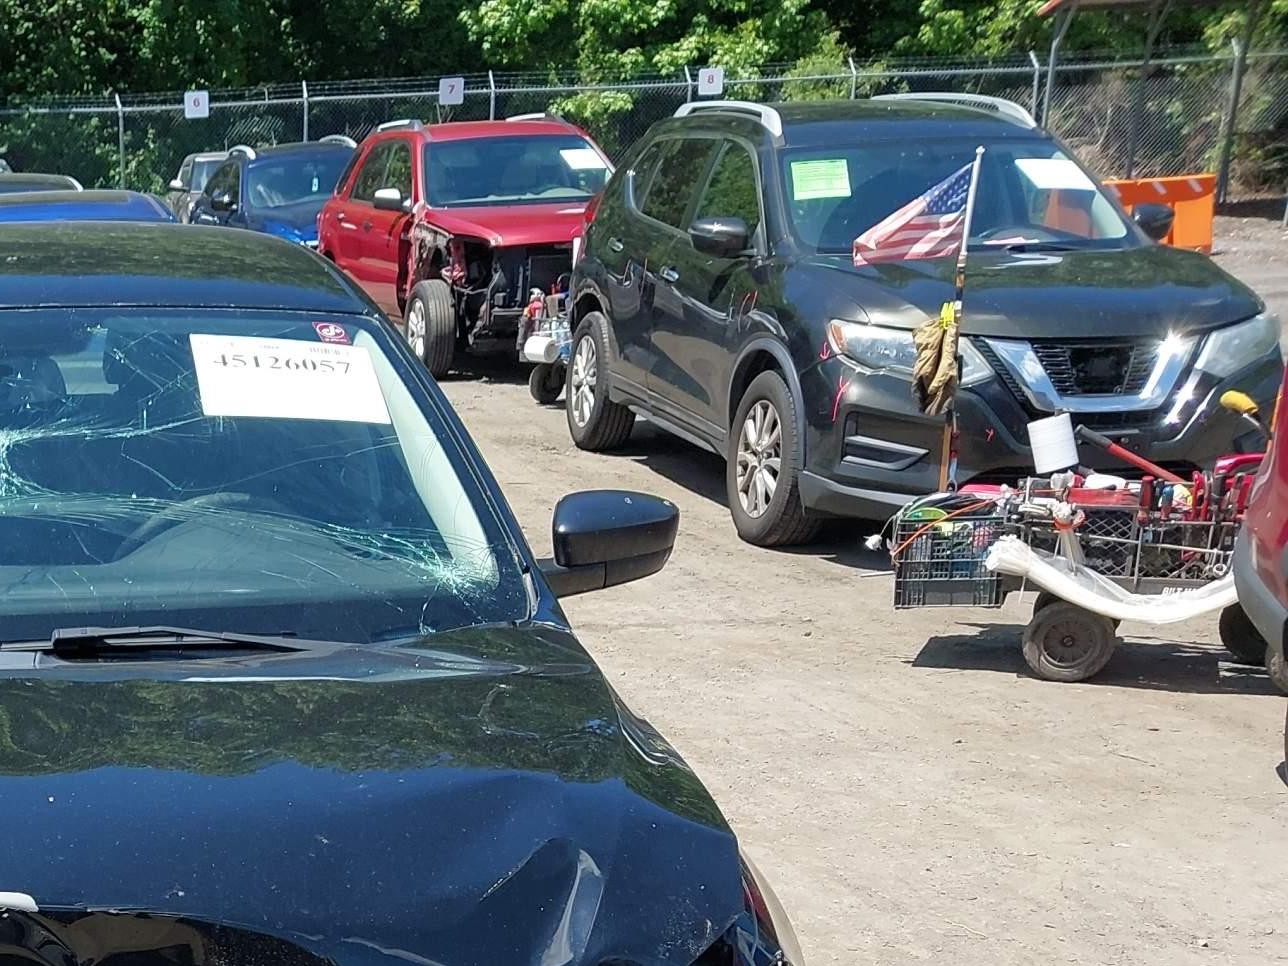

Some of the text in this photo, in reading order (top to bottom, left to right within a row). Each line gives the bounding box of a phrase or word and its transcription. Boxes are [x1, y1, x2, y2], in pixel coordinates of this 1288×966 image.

[707, 74, 714, 84] 8
[448, 84, 455, 95] 7
[193, 98, 200, 108] 6
[213, 354, 350, 374] 45126057
